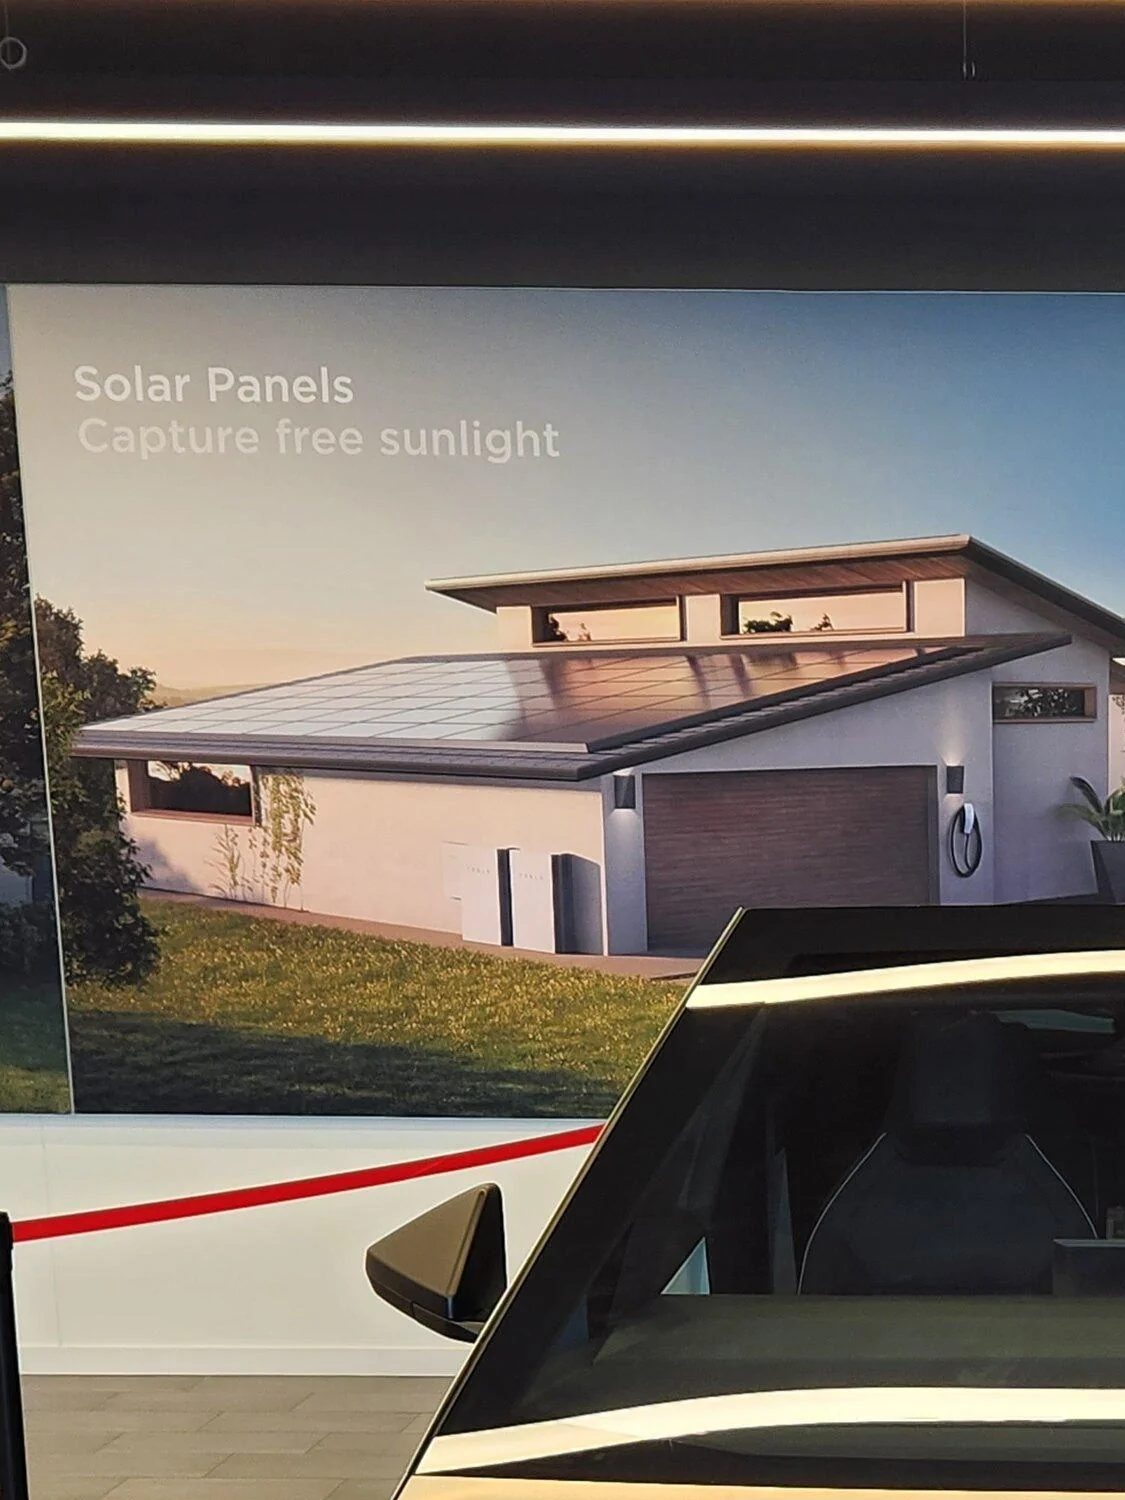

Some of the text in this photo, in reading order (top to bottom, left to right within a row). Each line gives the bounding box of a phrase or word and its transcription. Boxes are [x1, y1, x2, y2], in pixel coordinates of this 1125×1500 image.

[74, 365, 354, 404] Solar Panels
[77, 418, 560, 464] Capture free sunlight
